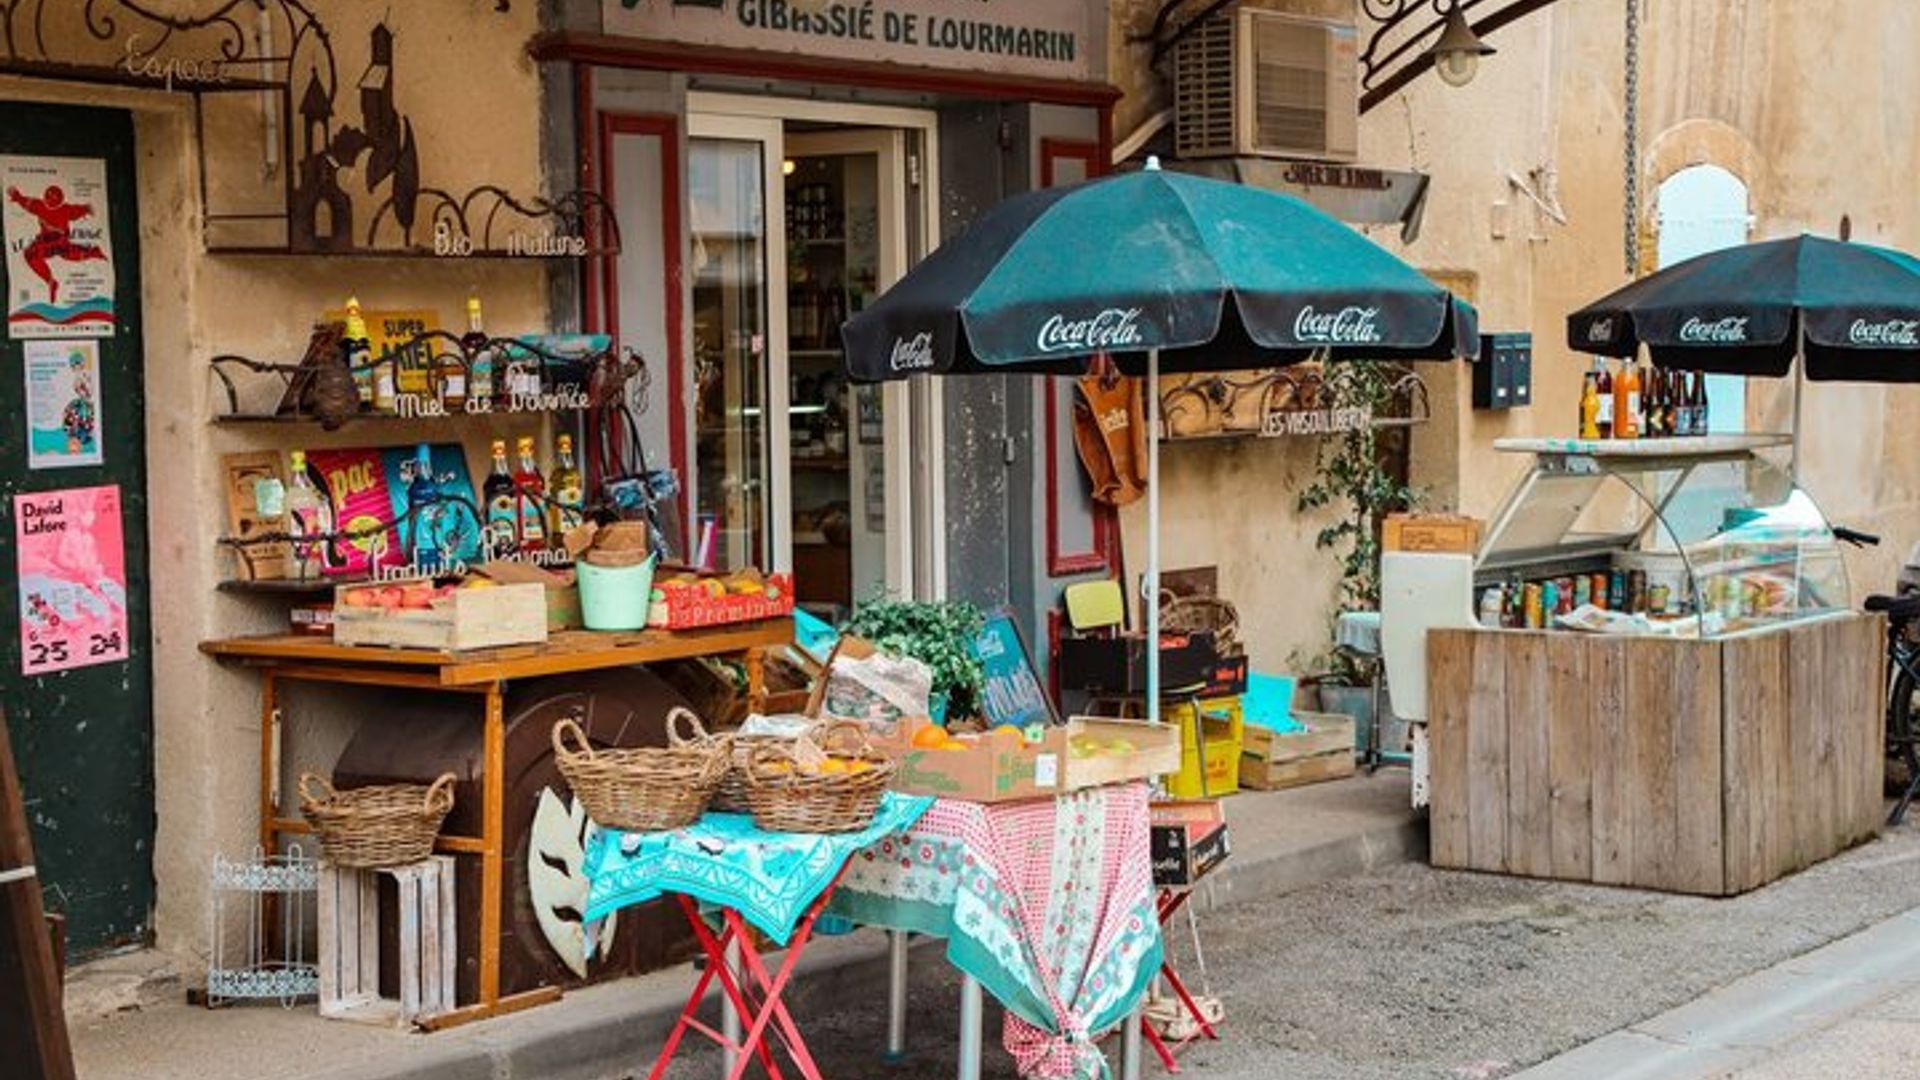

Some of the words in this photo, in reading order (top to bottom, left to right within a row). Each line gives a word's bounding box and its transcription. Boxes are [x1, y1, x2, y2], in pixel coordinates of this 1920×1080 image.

[884, 11, 918, 46] DE
[927, 16, 1075, 62] LOURMARIN
[1038, 308, 1143, 351] Coca-Cola
[1294, 305, 1381, 341] Coca-Cola
[394, 394, 450, 418] Miel
[464, 393, 493, 414] de
[22, 500, 64, 517] David
